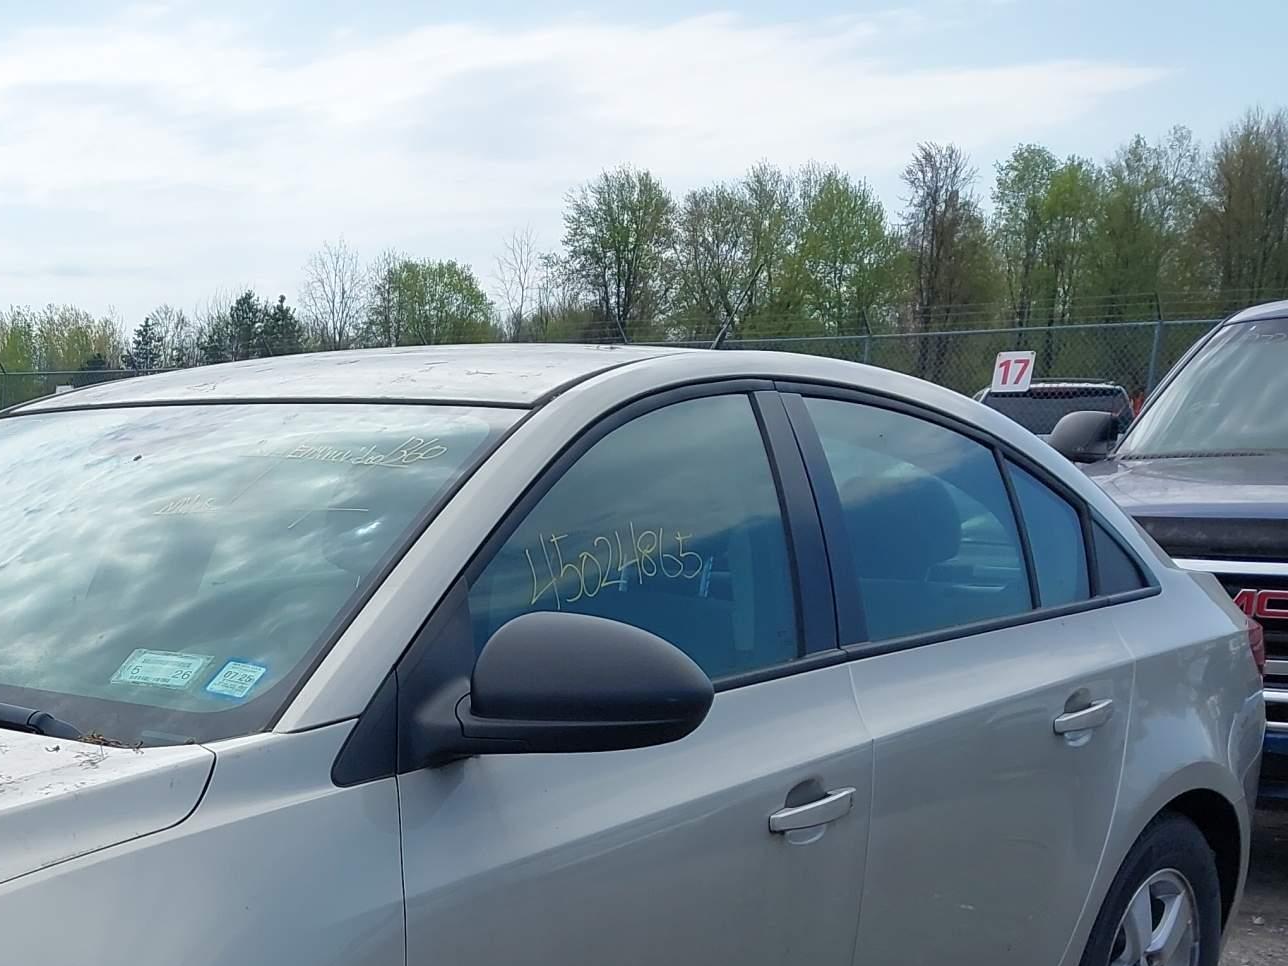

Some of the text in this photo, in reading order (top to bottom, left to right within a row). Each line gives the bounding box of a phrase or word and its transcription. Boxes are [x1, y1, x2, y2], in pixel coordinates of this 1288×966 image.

[998, 358, 1031, 385] 17
[525, 520, 704, 610] 45024865
[172, 669, 192, 680] 26
